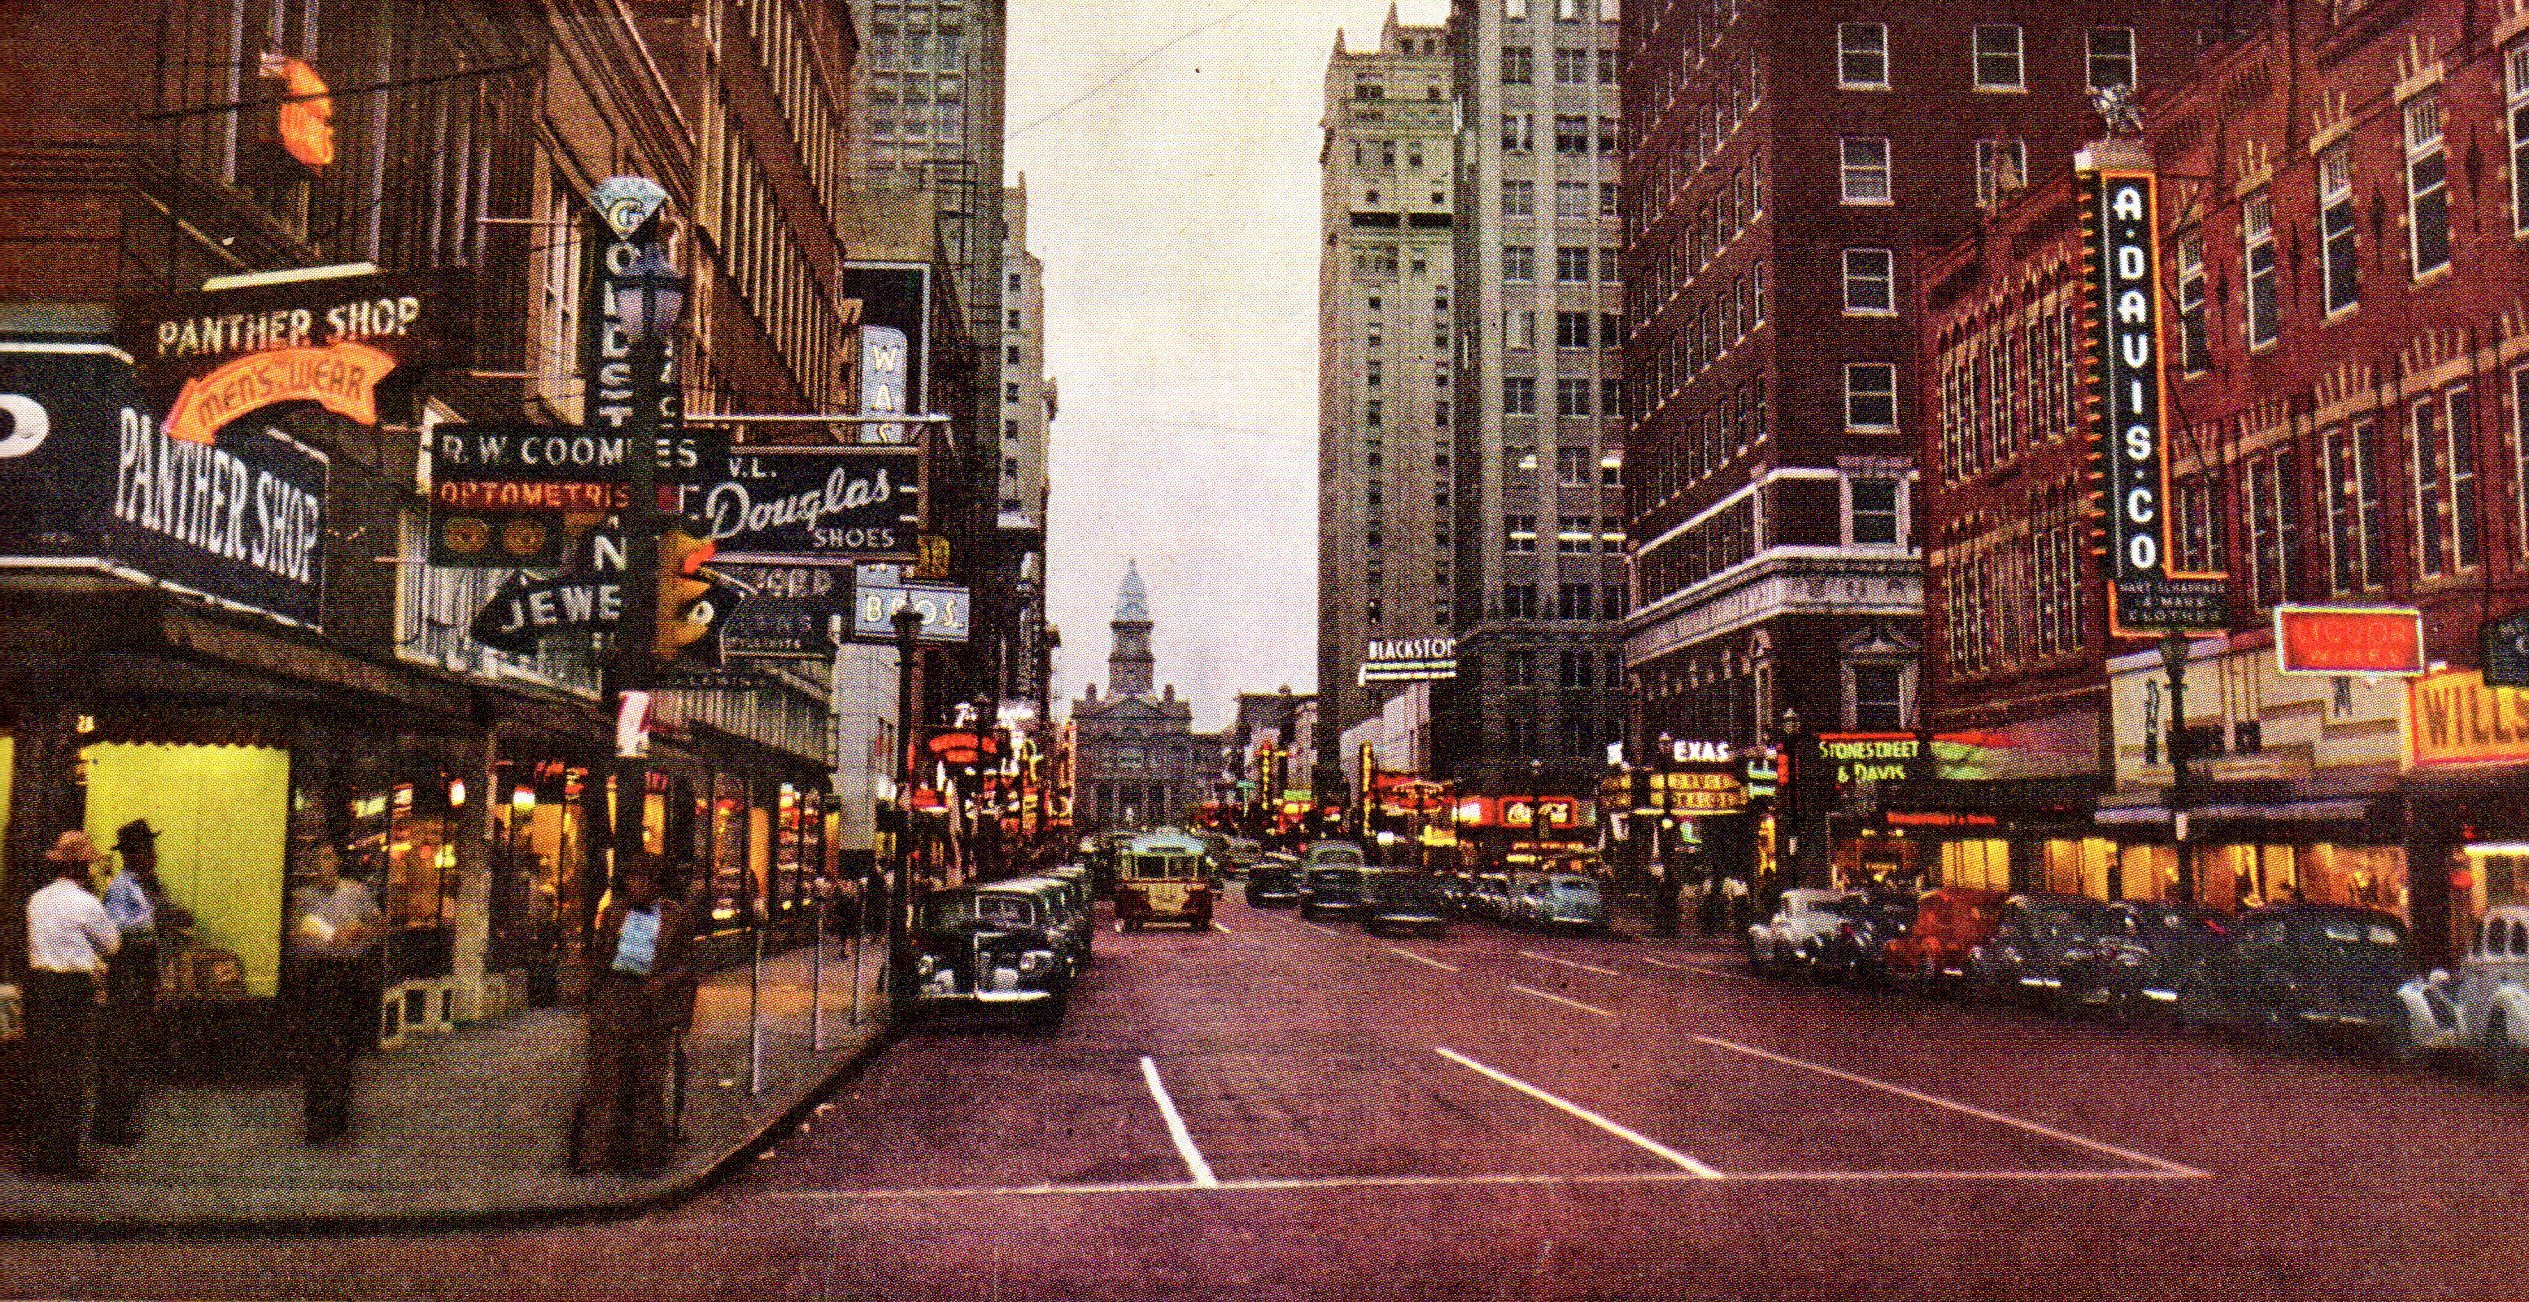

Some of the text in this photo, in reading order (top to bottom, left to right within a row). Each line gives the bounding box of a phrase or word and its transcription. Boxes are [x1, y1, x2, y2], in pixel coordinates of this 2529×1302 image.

[157, 294, 420, 356] PANTHER SHOP
[519, 434, 698, 468] COOMES
[114, 407, 249, 560] PANTHER
[251, 470, 320, 584] SHOP
[440, 480, 632, 508] OPTOMETRIS
[705, 465, 891, 539] Douglas
[812, 526, 896, 549] SHOES
[1673, 741, 1731, 763] EXAS
